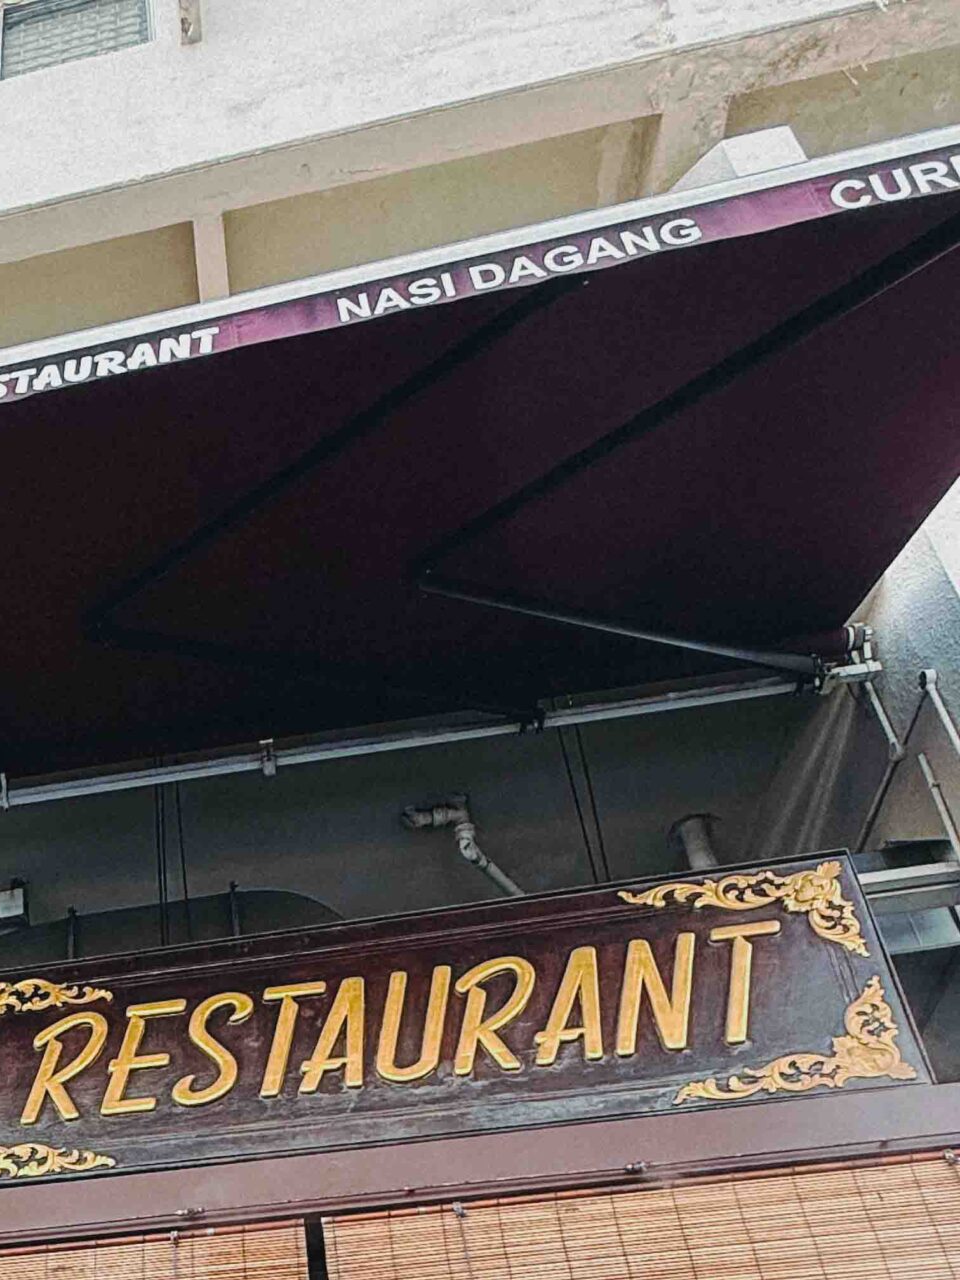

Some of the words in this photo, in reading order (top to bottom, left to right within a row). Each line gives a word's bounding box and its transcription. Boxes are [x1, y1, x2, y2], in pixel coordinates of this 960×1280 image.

[336, 270, 456, 322] NASI
[468, 217, 702, 290] DAGANG
[20, 919, 782, 1126] RESTAURANT
